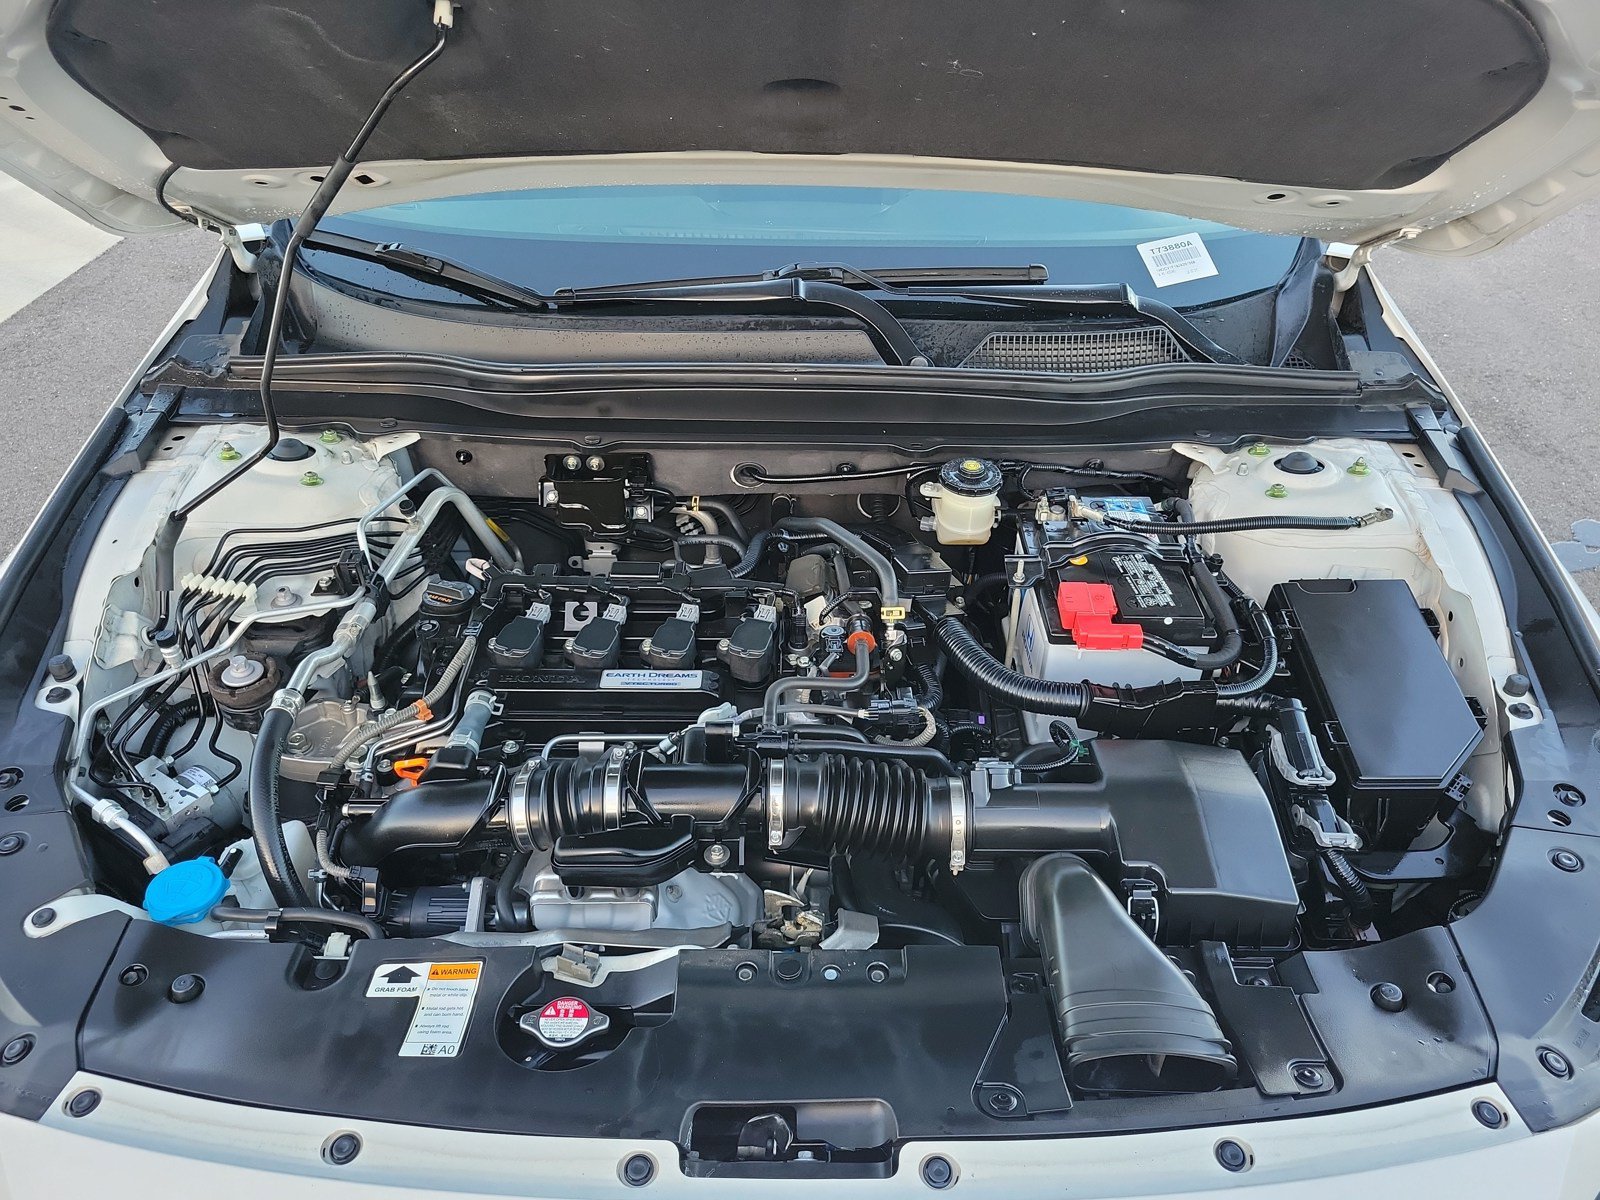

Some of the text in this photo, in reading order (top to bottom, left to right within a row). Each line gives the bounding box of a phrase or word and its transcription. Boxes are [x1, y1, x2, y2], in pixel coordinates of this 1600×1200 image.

[1149, 240, 1193, 255] T73880A
[499, 674, 585, 683] HONDA
[440, 968, 477, 976] WARNING
[437, 1045, 456, 1055] A0
